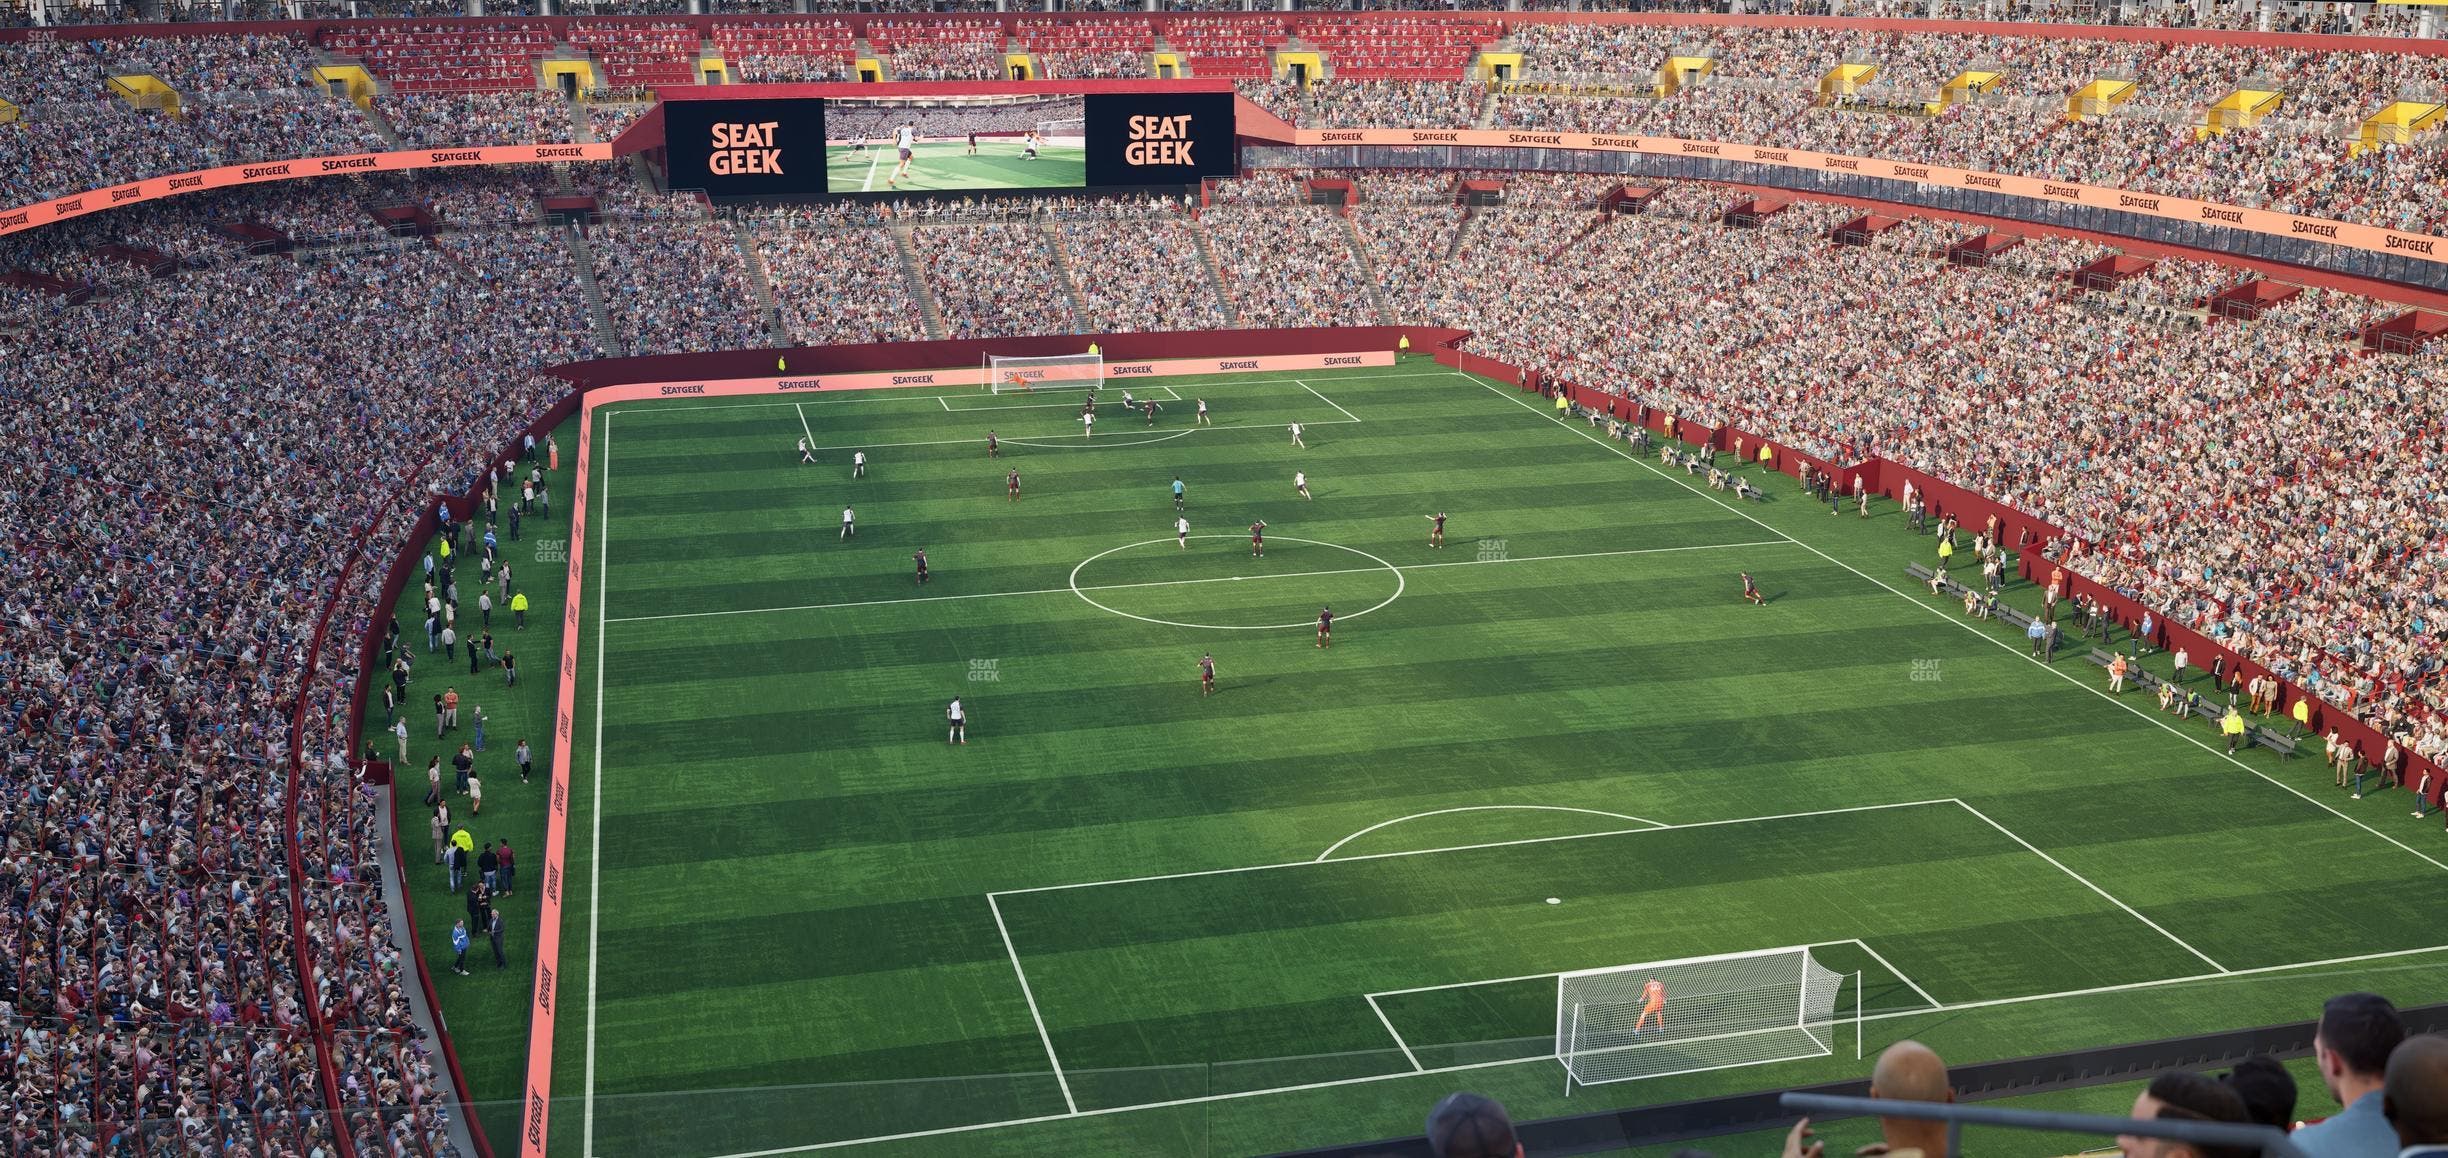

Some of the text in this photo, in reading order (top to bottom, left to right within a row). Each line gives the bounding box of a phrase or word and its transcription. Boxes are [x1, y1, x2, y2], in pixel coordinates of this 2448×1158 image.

[1129, 114, 1192, 140] SEAT
[711, 121, 779, 149] SEAT
[1321, 132, 1363, 142] SEATGEEK
[1412, 132, 1458, 142] SEATGEEK
[1509, 134, 1561, 145] SEATGEEK
[1591, 137, 1639, 149] SEATGEEK
[1682, 142, 1720, 156] SEATGEEK
[431, 150, 482, 164] SEATGEEK
[535, 146, 583, 159] SEATGEEK
[1125, 141, 1195, 166] GEEK
[1753, 149, 1789, 163] SEATGEEK
[321, 157, 378, 172] SEATGEEK
[707, 148, 784, 176] GEEK
[1825, 157, 1859, 171] SEATGEEK
[242, 163, 291, 180] SEATGEEK
[1893, 165, 1929, 180] SEATGEEK
[168, 175, 204, 191] SEATGEEK
[1964, 173, 2002, 189] SEATGEEK
[111, 186, 142, 203] SEATGEEK
[2043, 184, 2080, 200] SEATGEEK
[56, 198, 84, 216] SEATGEEK
[2119, 194, 2160, 212] SEATGEEK
[0, 210, 30, 231] SEATGEEK
[2201, 206, 2244, 225] SEATGEEK
[2291, 219, 2338, 240] SEATGEEK
[2385, 234, 2435, 256] SEATGEEK
[1219, 360, 1259, 371] SEATGEEK
[1323, 355, 1362, 367] SEATGEEK
[1113, 364, 1153, 376] SEATGEEK
[778, 378, 821, 391] SEATGEEK
[892, 373, 934, 387] SEATGEEK
[661, 383, 705, 396] SEATGEEK
[527, 1082, 546, 1155] SEATGEEK
